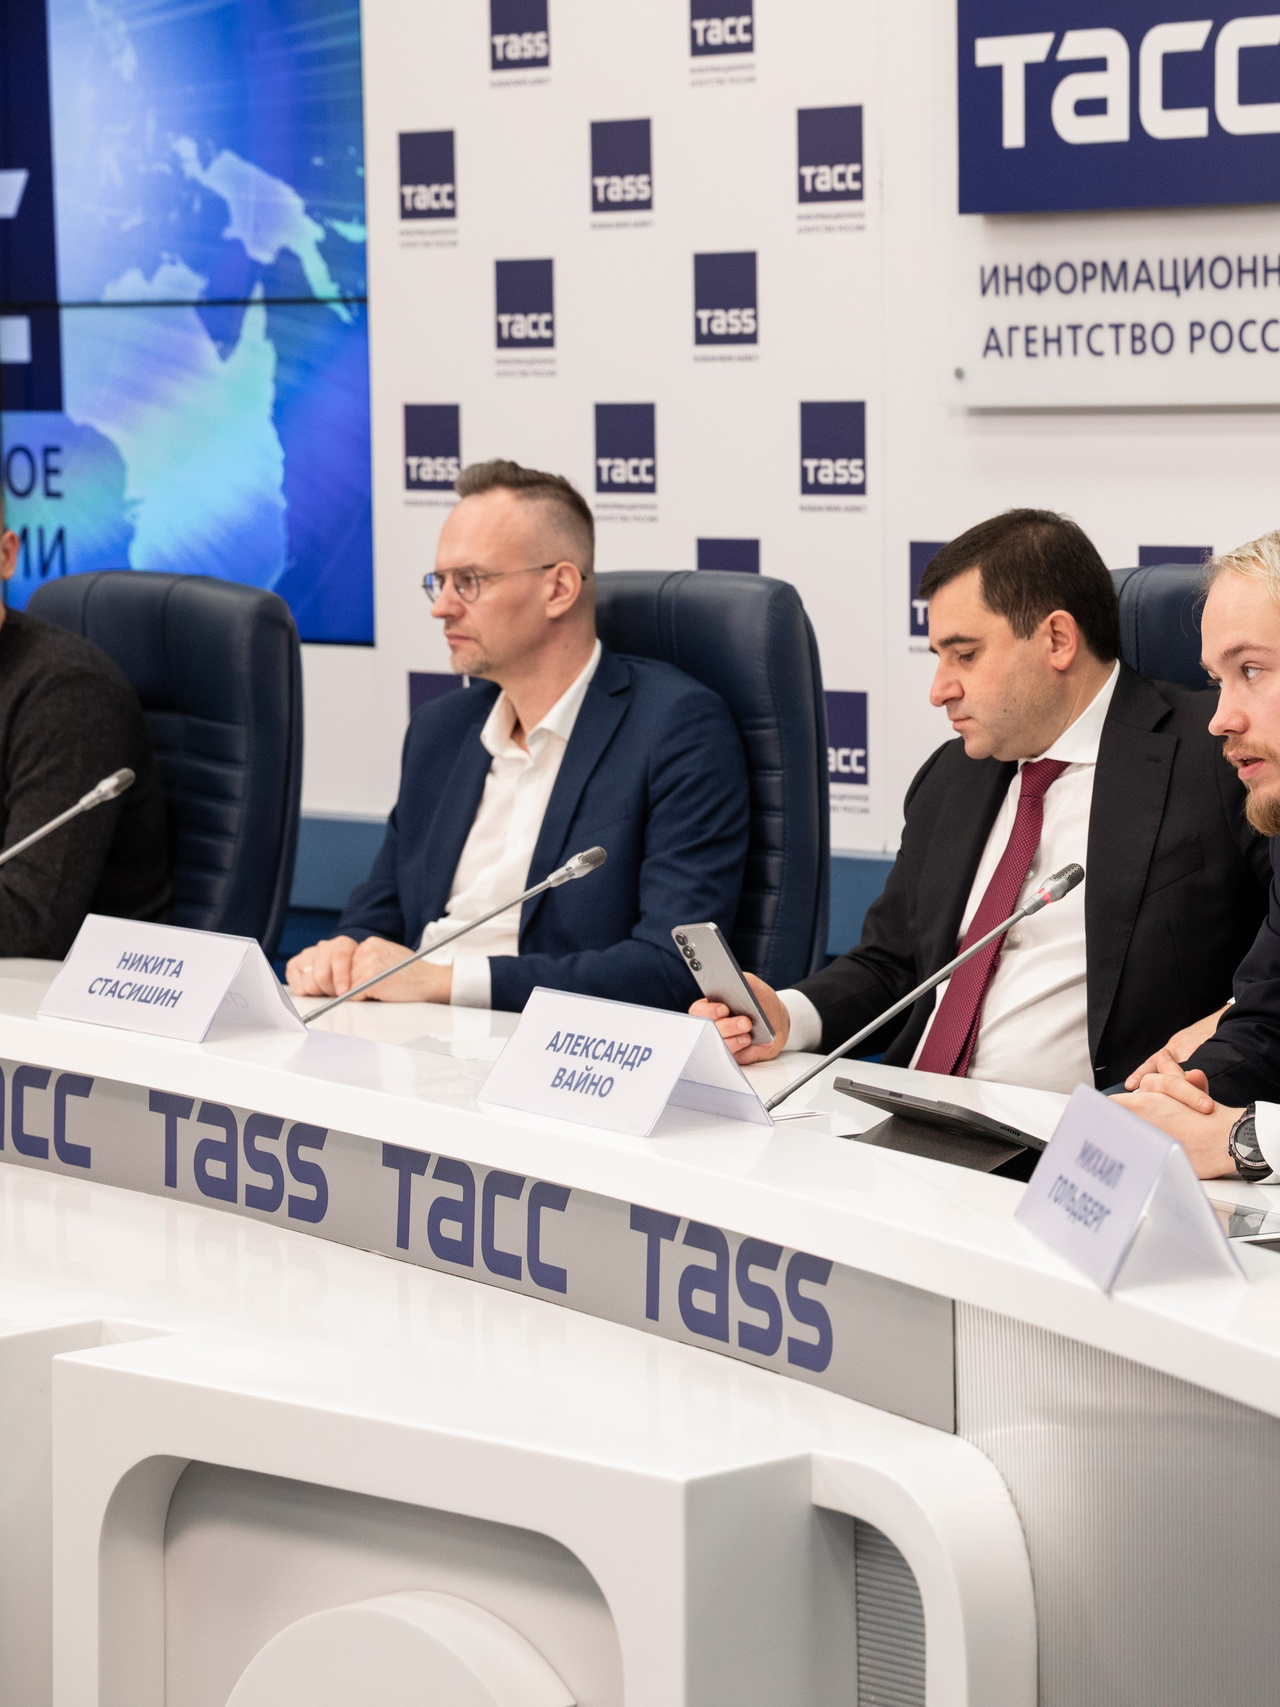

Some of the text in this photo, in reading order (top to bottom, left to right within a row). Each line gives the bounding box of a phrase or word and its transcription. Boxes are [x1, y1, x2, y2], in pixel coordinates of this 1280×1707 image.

[983, 322, 1175, 358] АГЕНТСТВО
[117, 951, 185, 979] НИКИТА
[88, 977, 183, 1009] СТАСИШИН
[545, 1030, 653, 1072] АЛЕКСАНДР
[550, 1067, 615, 1098] ВАЙНО
